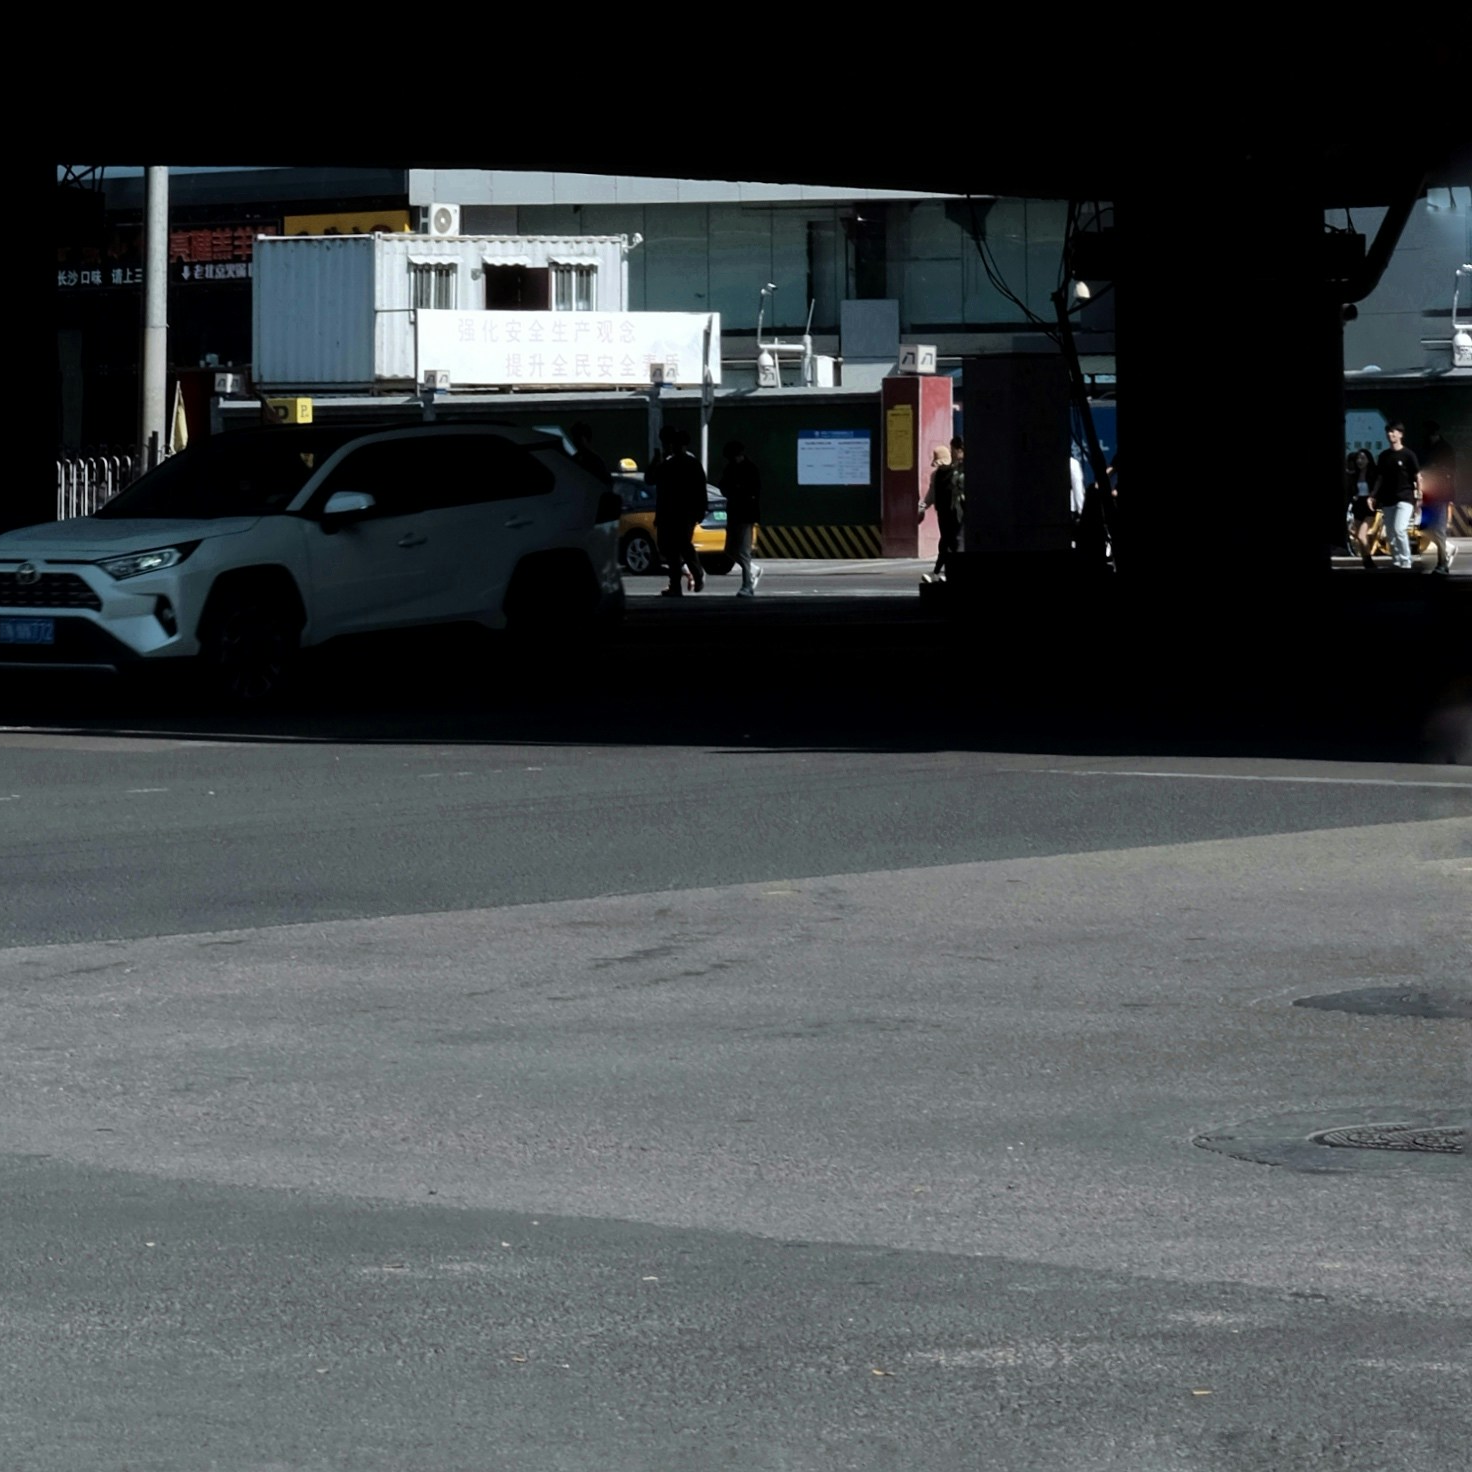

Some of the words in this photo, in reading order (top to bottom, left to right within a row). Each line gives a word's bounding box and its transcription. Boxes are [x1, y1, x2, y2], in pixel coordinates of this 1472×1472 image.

[458, 317, 637, 344] 强化安全生产观念
